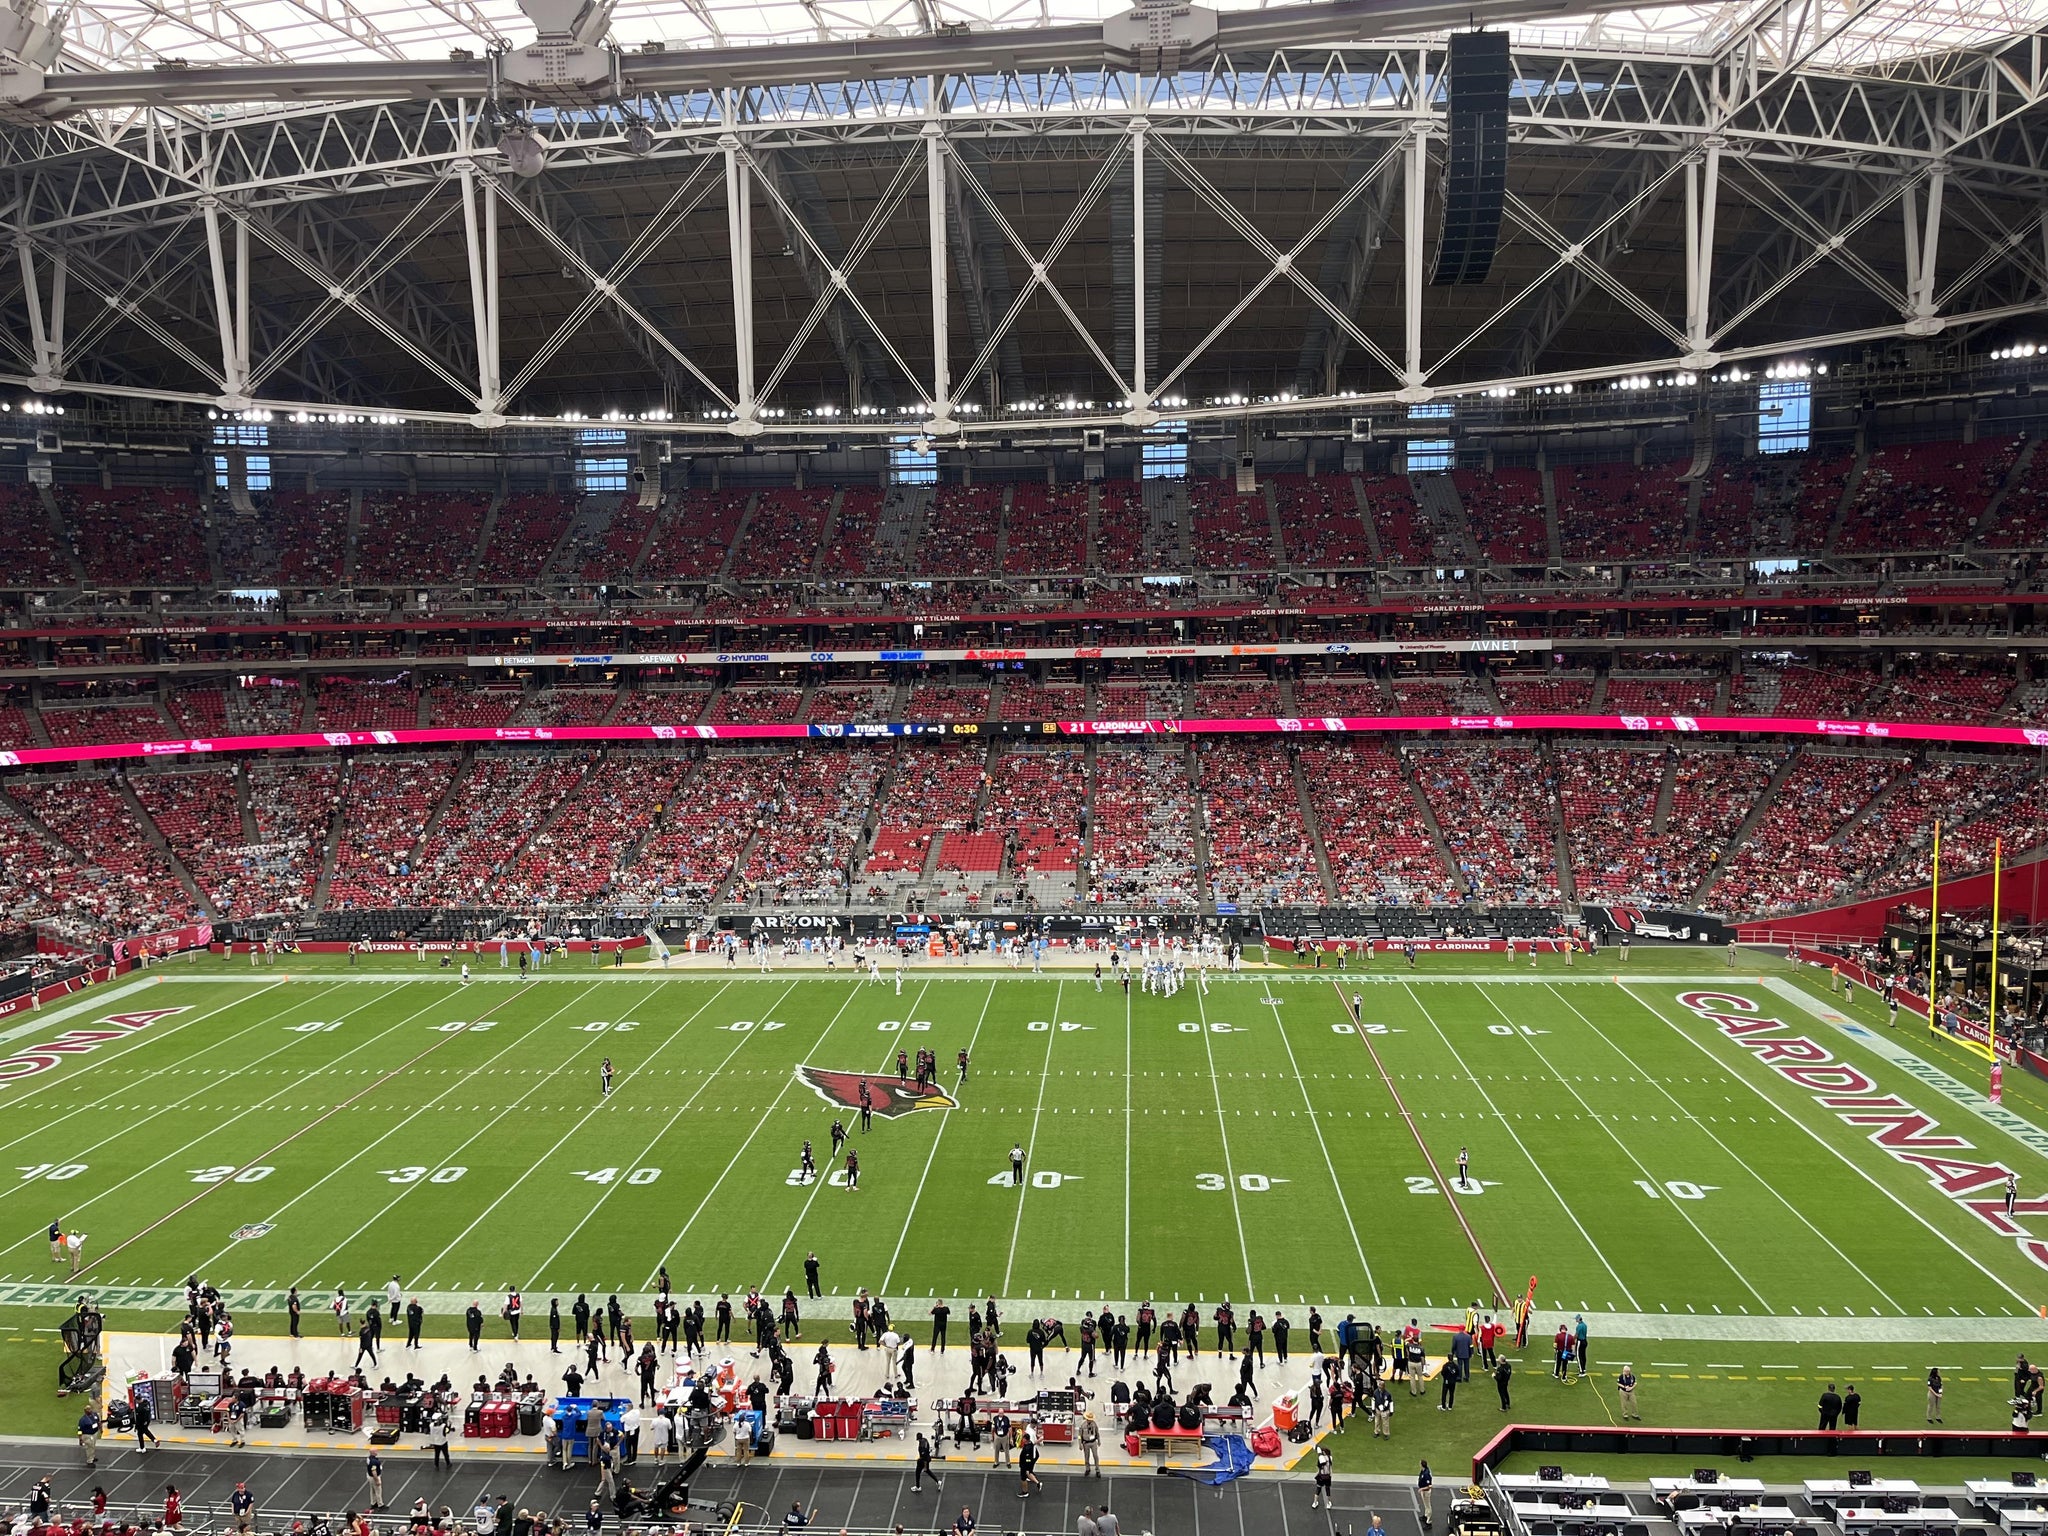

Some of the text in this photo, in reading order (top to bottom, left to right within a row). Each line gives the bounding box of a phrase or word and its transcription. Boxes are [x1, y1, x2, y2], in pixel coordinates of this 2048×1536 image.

[1328, 645, 1349, 653] Ford
[1470, 640, 1519, 651] AVNET
[503, 656, 535, 664] BETMGM
[639, 655, 675, 664] SAFEWAY
[810, 652, 834, 661] COX
[854, 725, 888, 733] TITANS
[903, 724, 912, 735] 6
[938, 724, 946, 735] 3
[953, 724, 978, 735] 0:30
[1044, 724, 1055, 732] 25
[1070, 723, 1085, 733] 21
[1091, 721, 1147, 731] CARDINALS
[752, 916, 842, 928] ARIONA
[358, 943, 406, 951] AIZONA
[1386, 943, 1491, 951] ARINA CARDINALS
[0, 1004, 196, 1090] ONA
[1893, 1057, 2048, 1153] CRUCIAL CATC
[20, 1163, 89, 1180] 10
[190, 1166, 276, 1182] 20
[387, 1166, 469, 1183] 30
[584, 1167, 663, 1184] 40
[785, 1169, 861, 1187] 50
[986, 1171, 1062, 1188] 40
[1195, 1173, 1270, 1191] 30
[1403, 1176, 1485, 1195] 20
[1632, 1180, 1706, 1199] 10
[210, 1292, 390, 1311] ANCER
[512, 1297, 519, 1308] K
[32, 1490, 39, 1502] 11
[477, 1516, 487, 1524] 27
